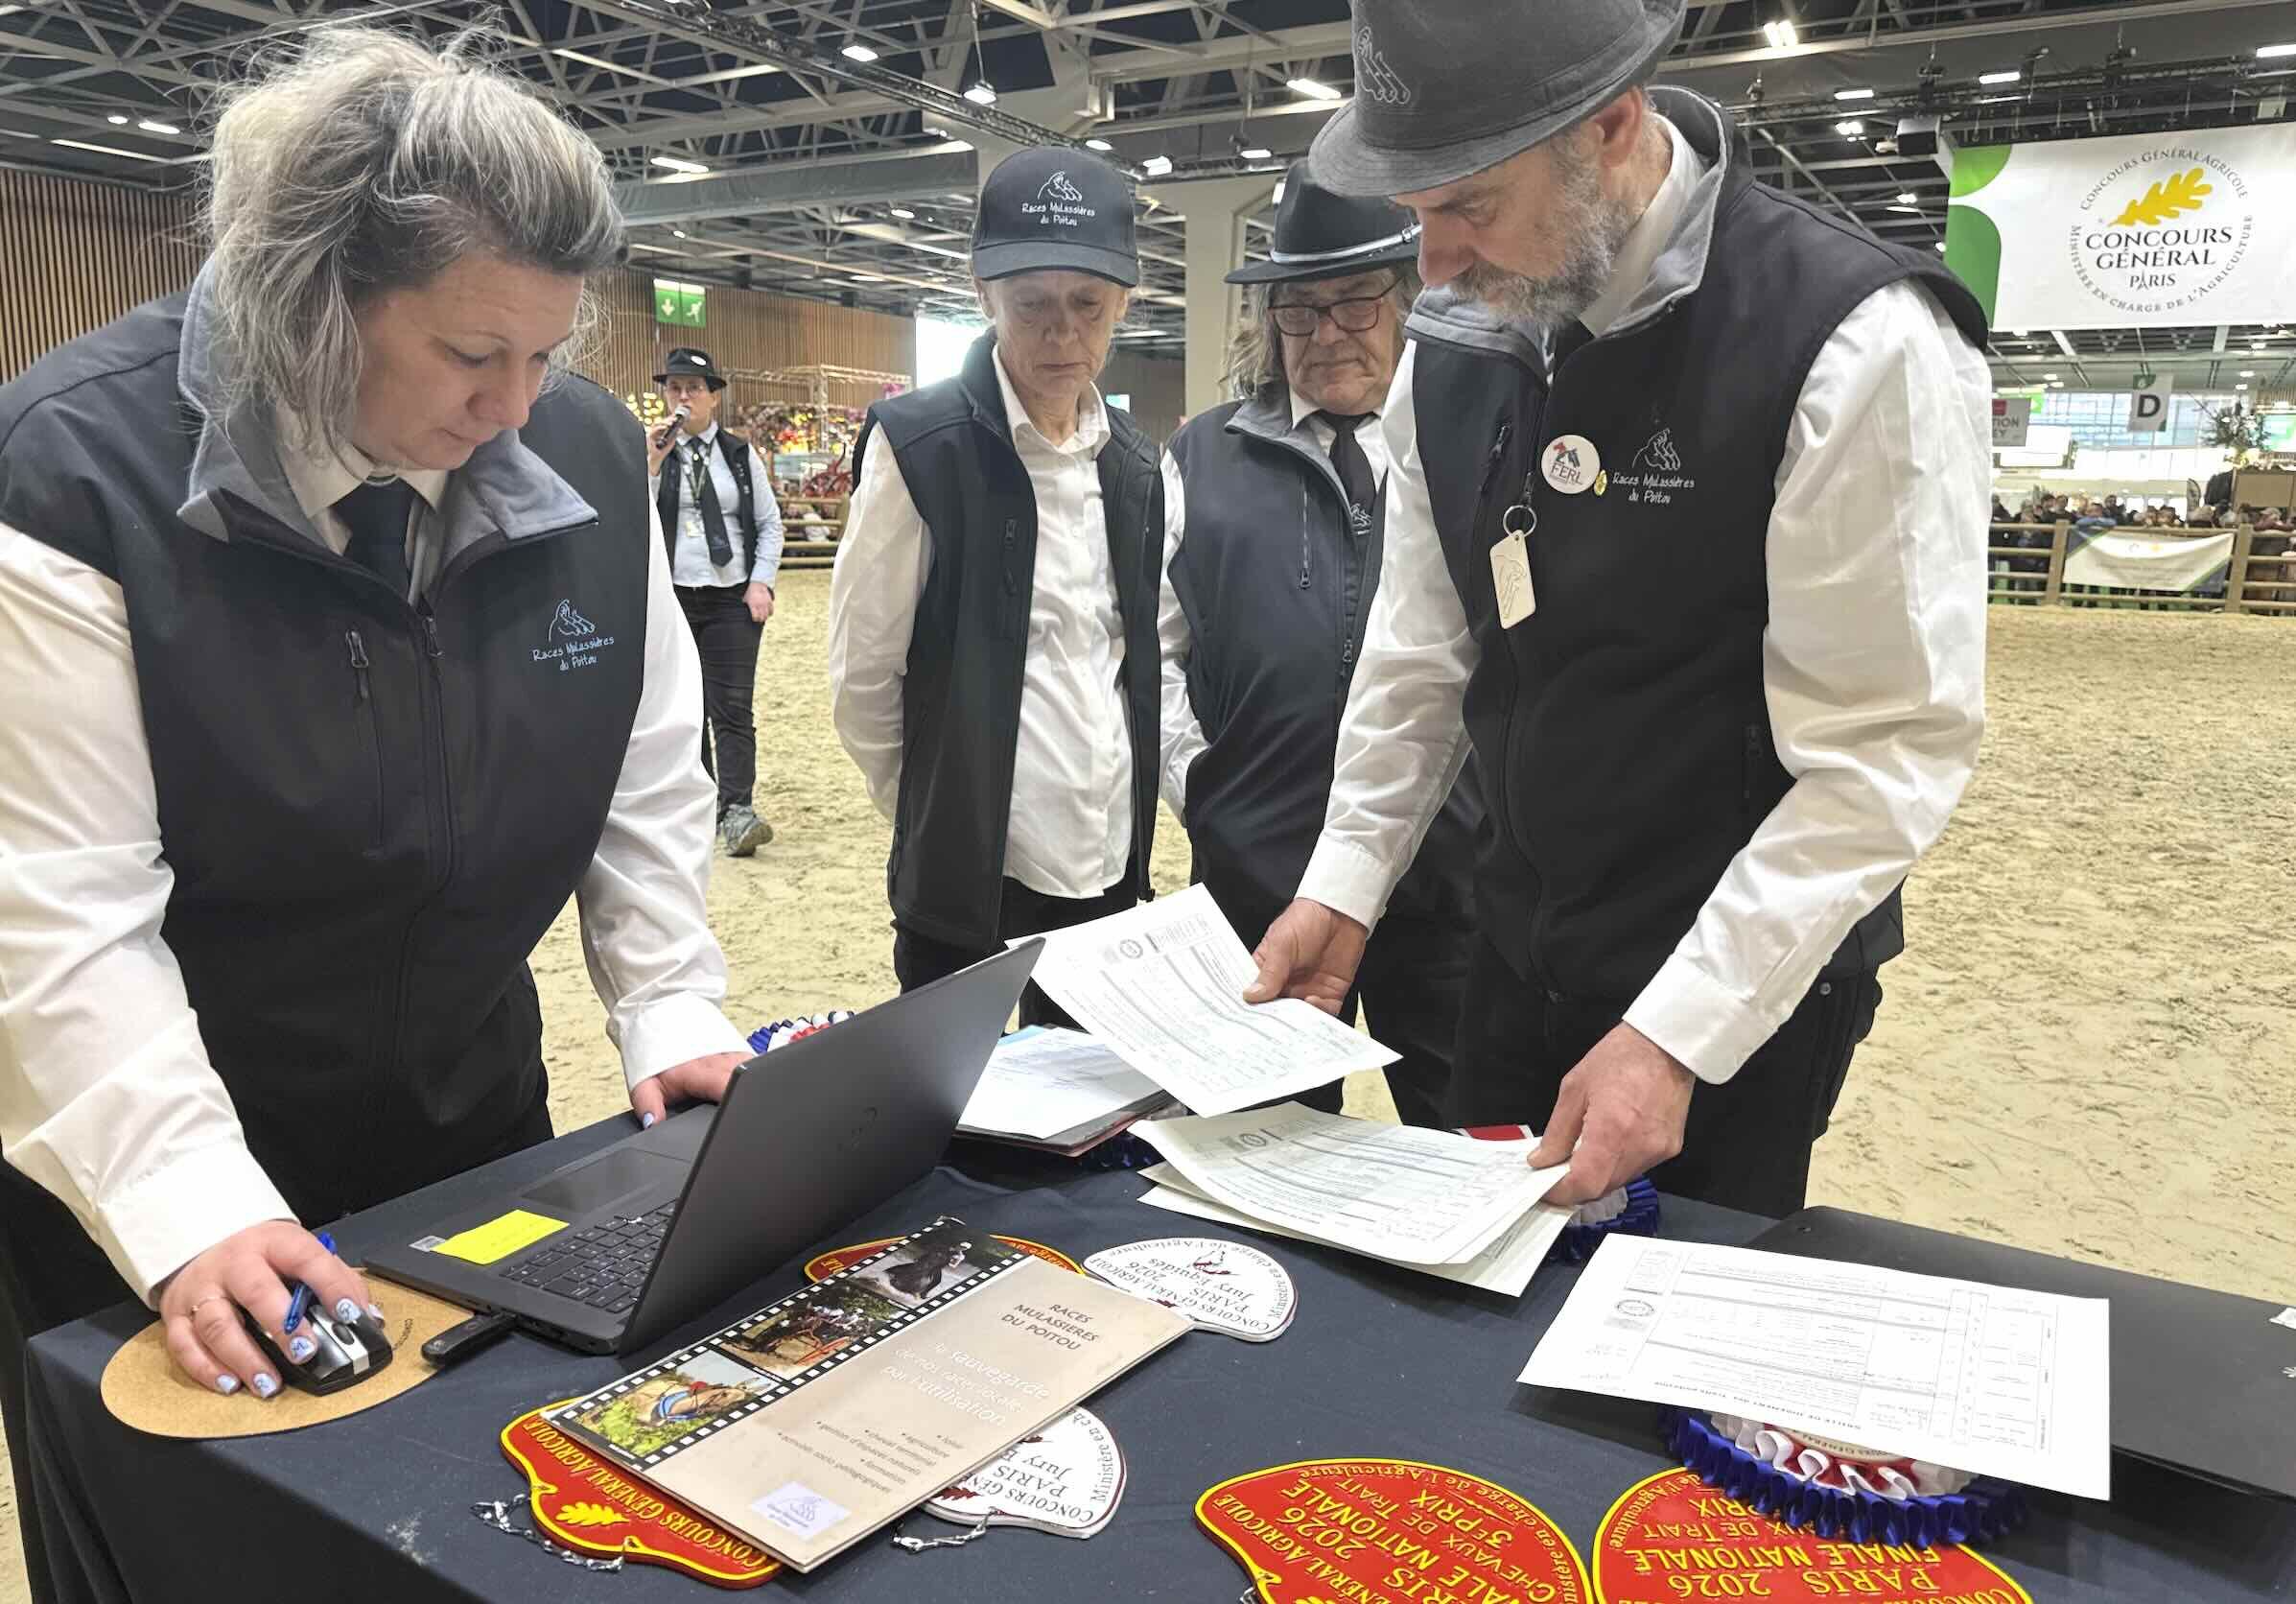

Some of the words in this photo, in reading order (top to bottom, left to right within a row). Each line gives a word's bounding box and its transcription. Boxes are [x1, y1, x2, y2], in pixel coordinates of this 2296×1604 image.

[1021, 202, 1047, 214] Races
[1053, 215, 1078, 226] Poitou
[2085, 225, 2233, 250] CONCOURS
[2096, 246, 2216, 271] GÉNÉRAL
[2129, 271, 2177, 291] PARIS
[2109, 297, 2162, 313] CHARGE
[2166, 298, 2185, 310] DE
[2137, 393, 2162, 419] D
[1612, 472, 1639, 485] Races
[1628, 489, 1639, 502] du
[1643, 490, 1671, 505] Poitou
[531, 649, 564, 661] Races
[1124, 1262, 1166, 1281] 2026
[1190, 1287, 1249, 1312] PARIS
[1213, 1284, 1254, 1301] Jury
[1049, 1305, 1093, 1323] RACES
[1200, 1304, 1269, 1331] CONCOURS
[1001, 1314, 1025, 1326] DU
[1025, 1324, 1081, 1350] POITOU
[522, 1420, 597, 1474] AGRICOLE
[1022, 1455, 1074, 1479] Jury
[1089, 1444, 1114, 1503] Ministère
[994, 1465, 1067, 1498] PARIS
[1444, 1476, 1470, 1490] de
[1005, 1488, 1093, 1522] CONCOURS
[1334, 1477, 1400, 1520] TRAIT
[1409, 1488, 1484, 1533] PRIX
[1477, 1487, 1537, 1526] charge
[1212, 1494, 1312, 1564] AGRICOLE
[1277, 1507, 1366, 1561] 2026
[1281, 1479, 1441, 1570] NATIONALE
[1400, 1512, 1439, 1535] DE
[1643, 1522, 1723, 1543] TRAIT
[1720, 1521, 1759, 1537] DE
[659, 1511, 766, 1568] CONCOURS
[1535, 1528, 1556, 1549] en
[1625, 1545, 1813, 1572] NATIONALE
[1816, 1543, 1941, 1566] FINALE
[1442, 1532, 1556, 1603] CHEVAUX
[1550, 1550, 1579, 1604] nistère
[1384, 1568, 1462, 1604] RIS
[1669, 1572, 1771, 1598] 2026
[1802, 1568, 1940, 1593] PARIS
